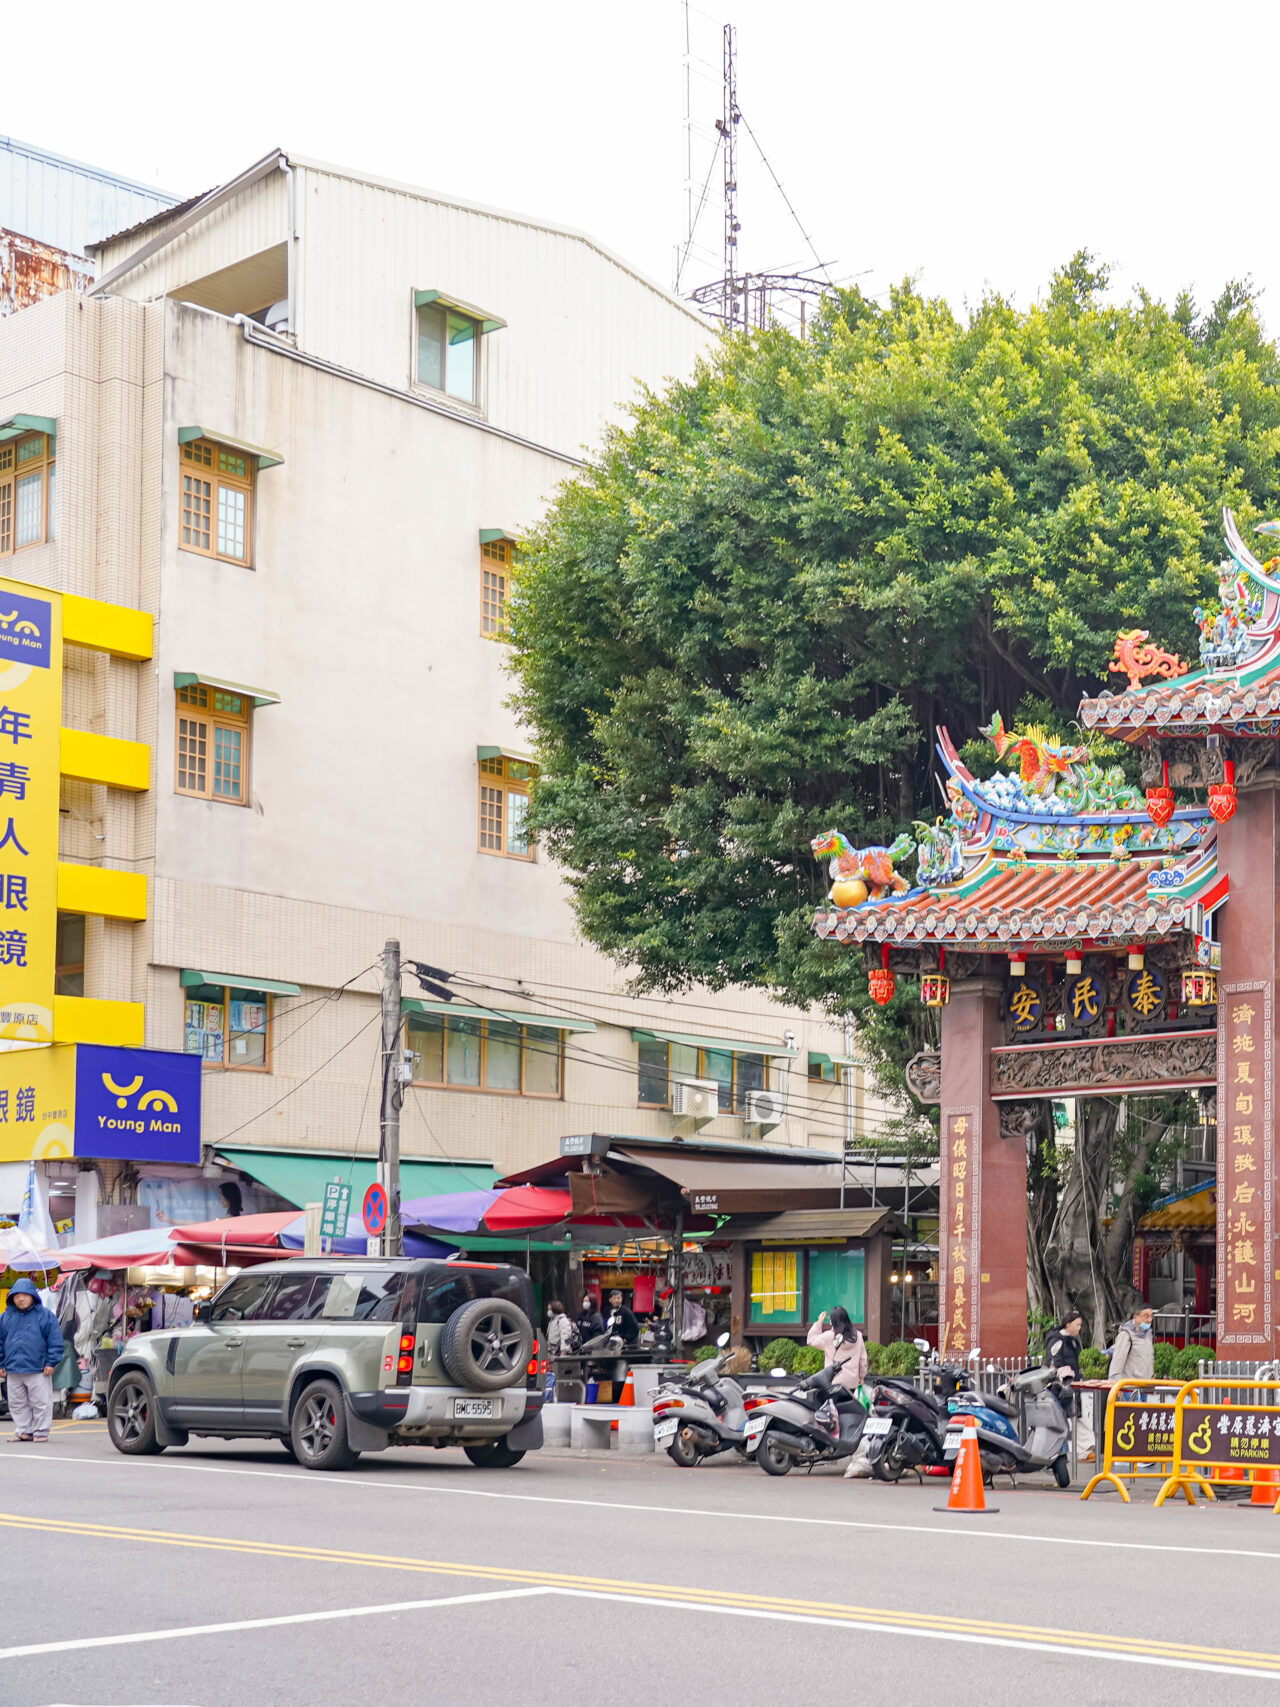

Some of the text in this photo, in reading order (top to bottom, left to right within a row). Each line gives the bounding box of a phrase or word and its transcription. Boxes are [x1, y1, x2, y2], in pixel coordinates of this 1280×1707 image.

[22, 638, 42, 649] Man
[0, 704, 32, 968] 年青人眼鏡
[1010, 983, 1040, 1024] 安
[1072, 976, 1098, 1018] 民
[1130, 970, 1161, 1015] 泰
[0, 1011, 39, 1026] 豐原店
[98, 1116, 181, 1133] Young Man
[952, 1117, 969, 1351] 母儀昭日月千秋國泰民安
[1139, 1411, 1175, 1431] 豐原慈濟
[1231, 1437, 1269, 1449] 請勿停車
[1230, 1449, 1269, 1459] NO PARKING
